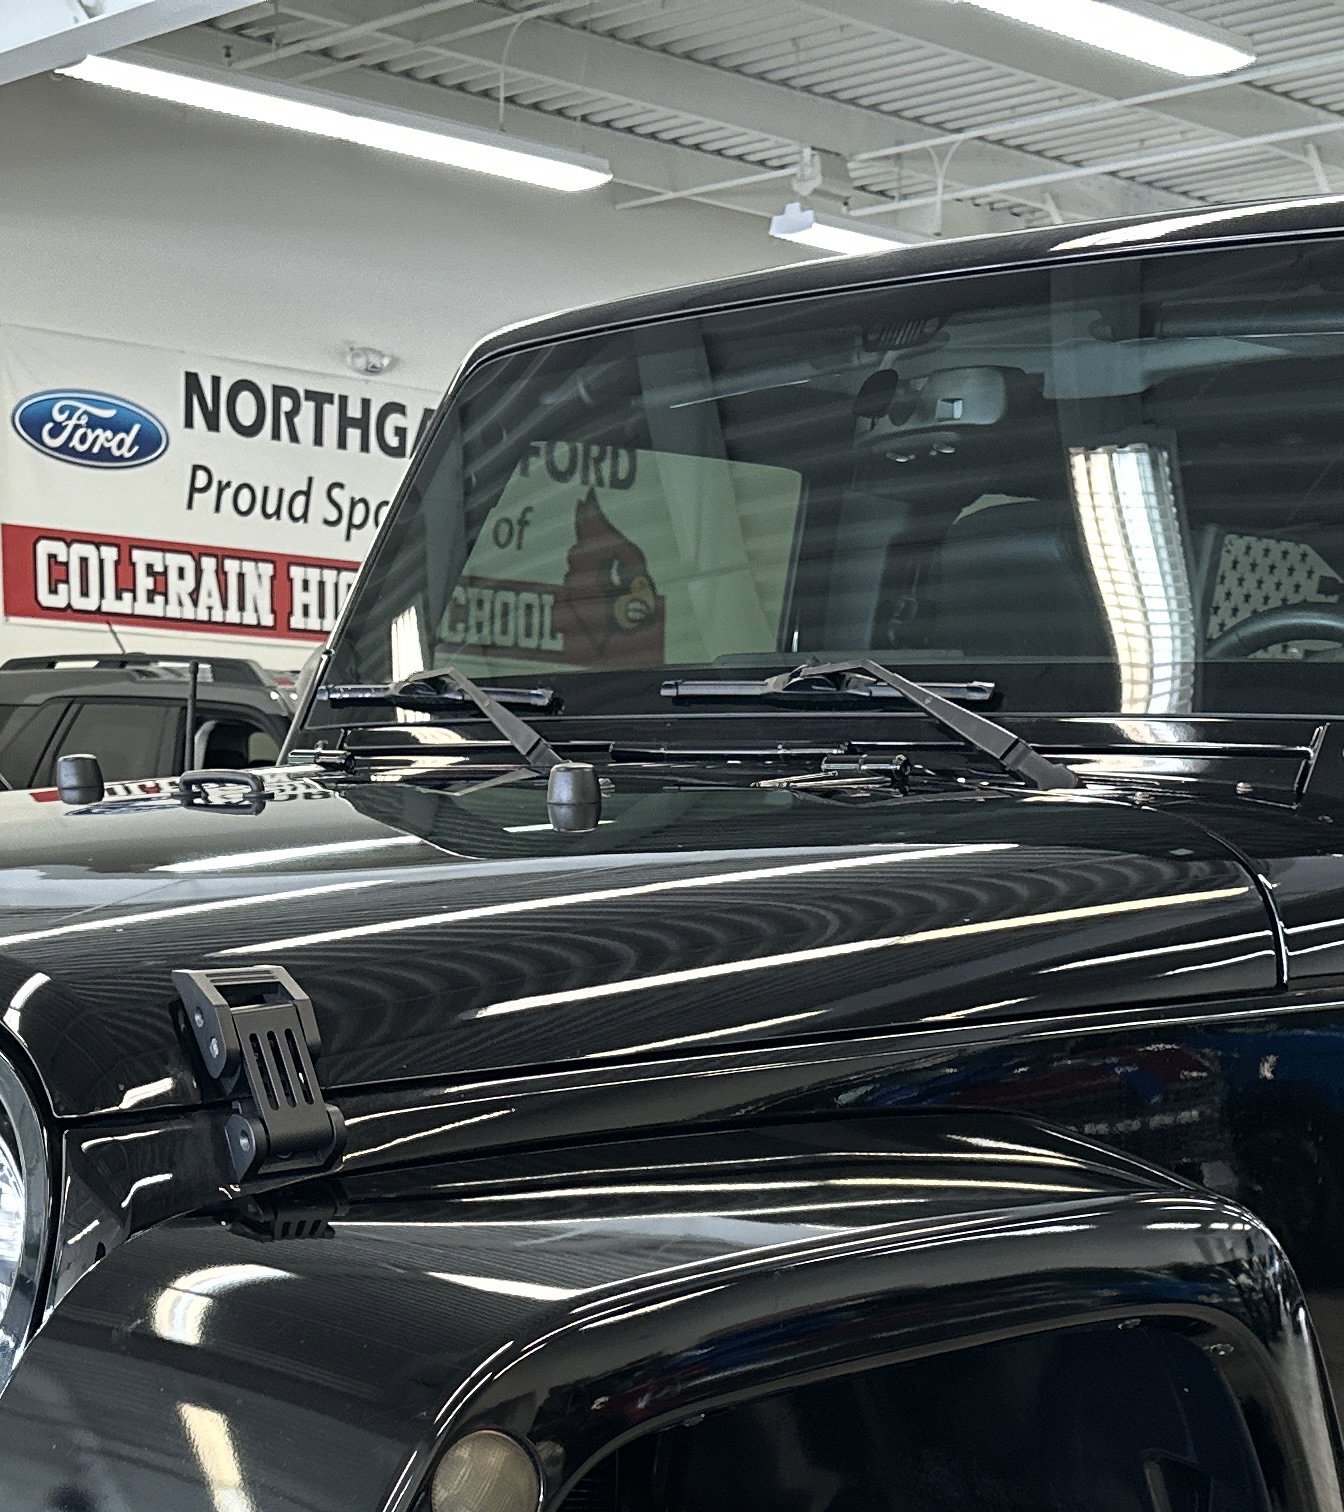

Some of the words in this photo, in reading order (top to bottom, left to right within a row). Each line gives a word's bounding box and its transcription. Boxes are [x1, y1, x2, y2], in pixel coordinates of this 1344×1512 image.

[41, 399, 143, 459] Ford
[519, 440, 638, 491] FORD
[186, 464, 314, 524] Proud
[492, 506, 534, 550] of
[34, 536, 276, 629] COLERAIN
